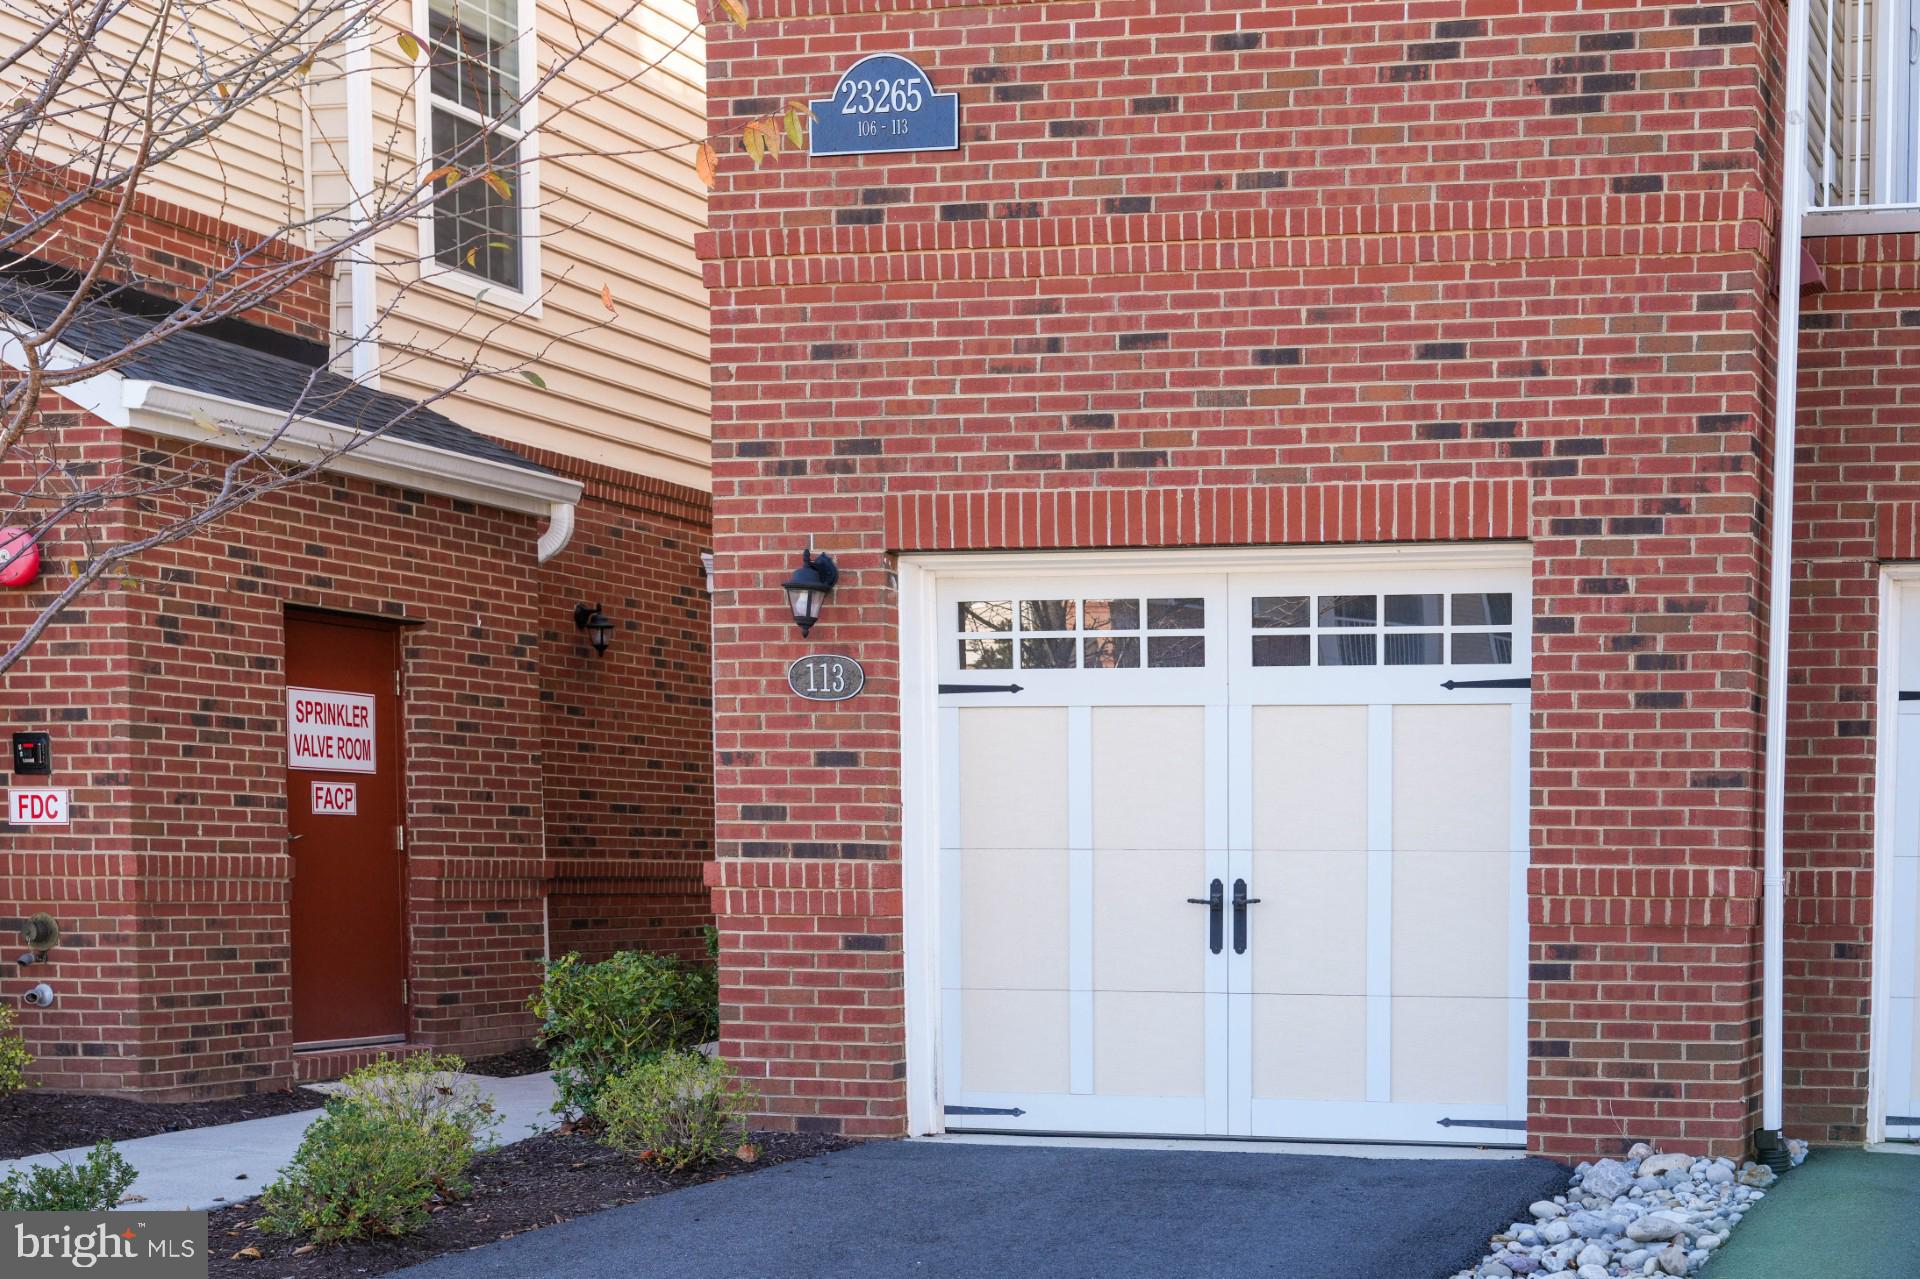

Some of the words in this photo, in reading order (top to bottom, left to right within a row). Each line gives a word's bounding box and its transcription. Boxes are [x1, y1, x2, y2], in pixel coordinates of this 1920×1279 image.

[841, 78, 922, 114] 23265
[857, 120, 877, 137] 106
[892, 118, 909, 135] 113
[806, 663, 845, 692] 113
[295, 700, 369, 728] SPRINKLER
[294, 733, 334, 758] VALVE
[337, 736, 371, 761] ROOM
[18, 794, 58, 819] FDC
[315, 786, 353, 810] FACP
